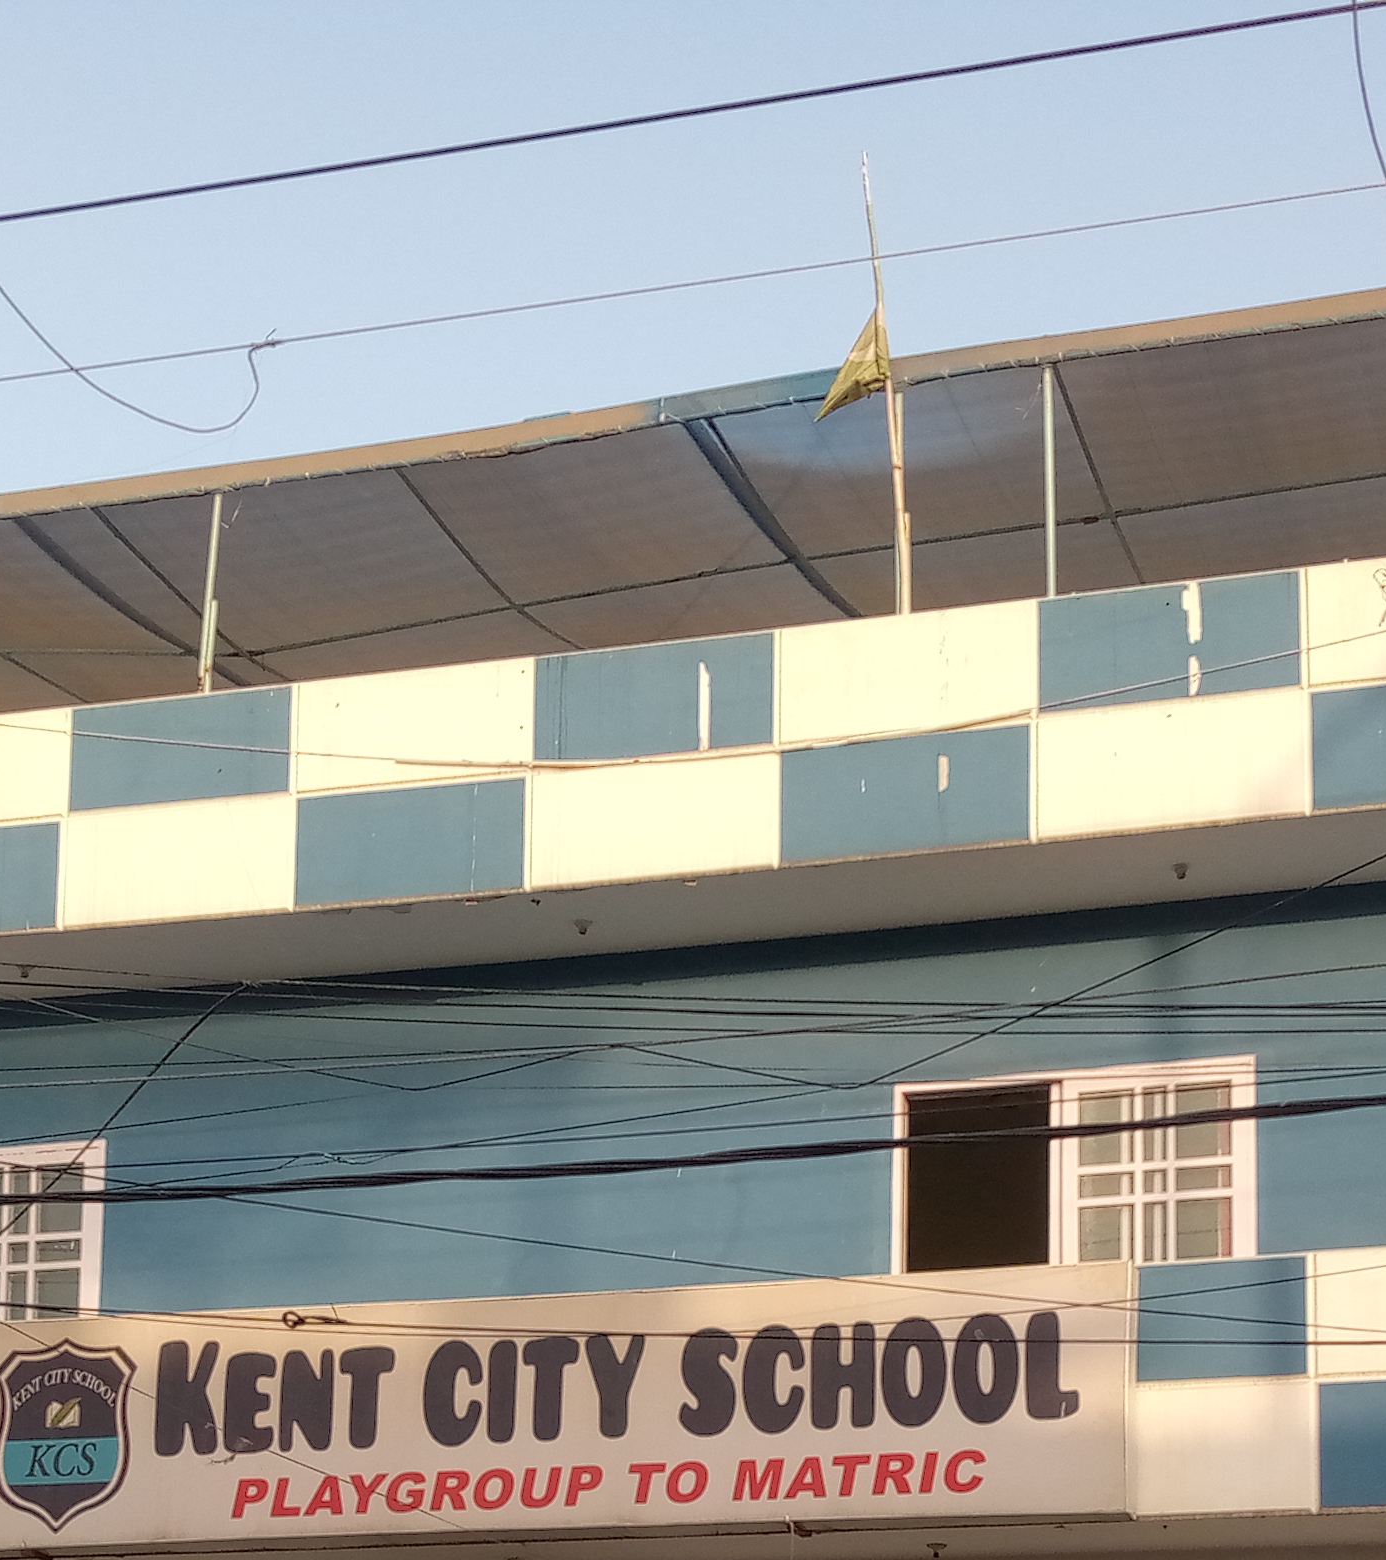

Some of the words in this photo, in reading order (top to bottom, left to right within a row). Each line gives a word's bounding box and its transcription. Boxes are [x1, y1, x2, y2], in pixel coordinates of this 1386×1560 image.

[12, 1376, 42, 1411] KENT
[44, 1368, 72, 1387] CITY
[72, 1369, 116, 1407] SCHOOL
[154, 1340, 396, 1457] KENT
[423, 1334, 644, 1447] CITY
[679, 1311, 1079, 1437] SCHOOL
[25, 1442, 97, 1478] KCS
[231, 1464, 603, 1519] PLAYGROUP
[628, 1461, 708, 1504] TO
[732, 1449, 987, 1502] MATRIC
